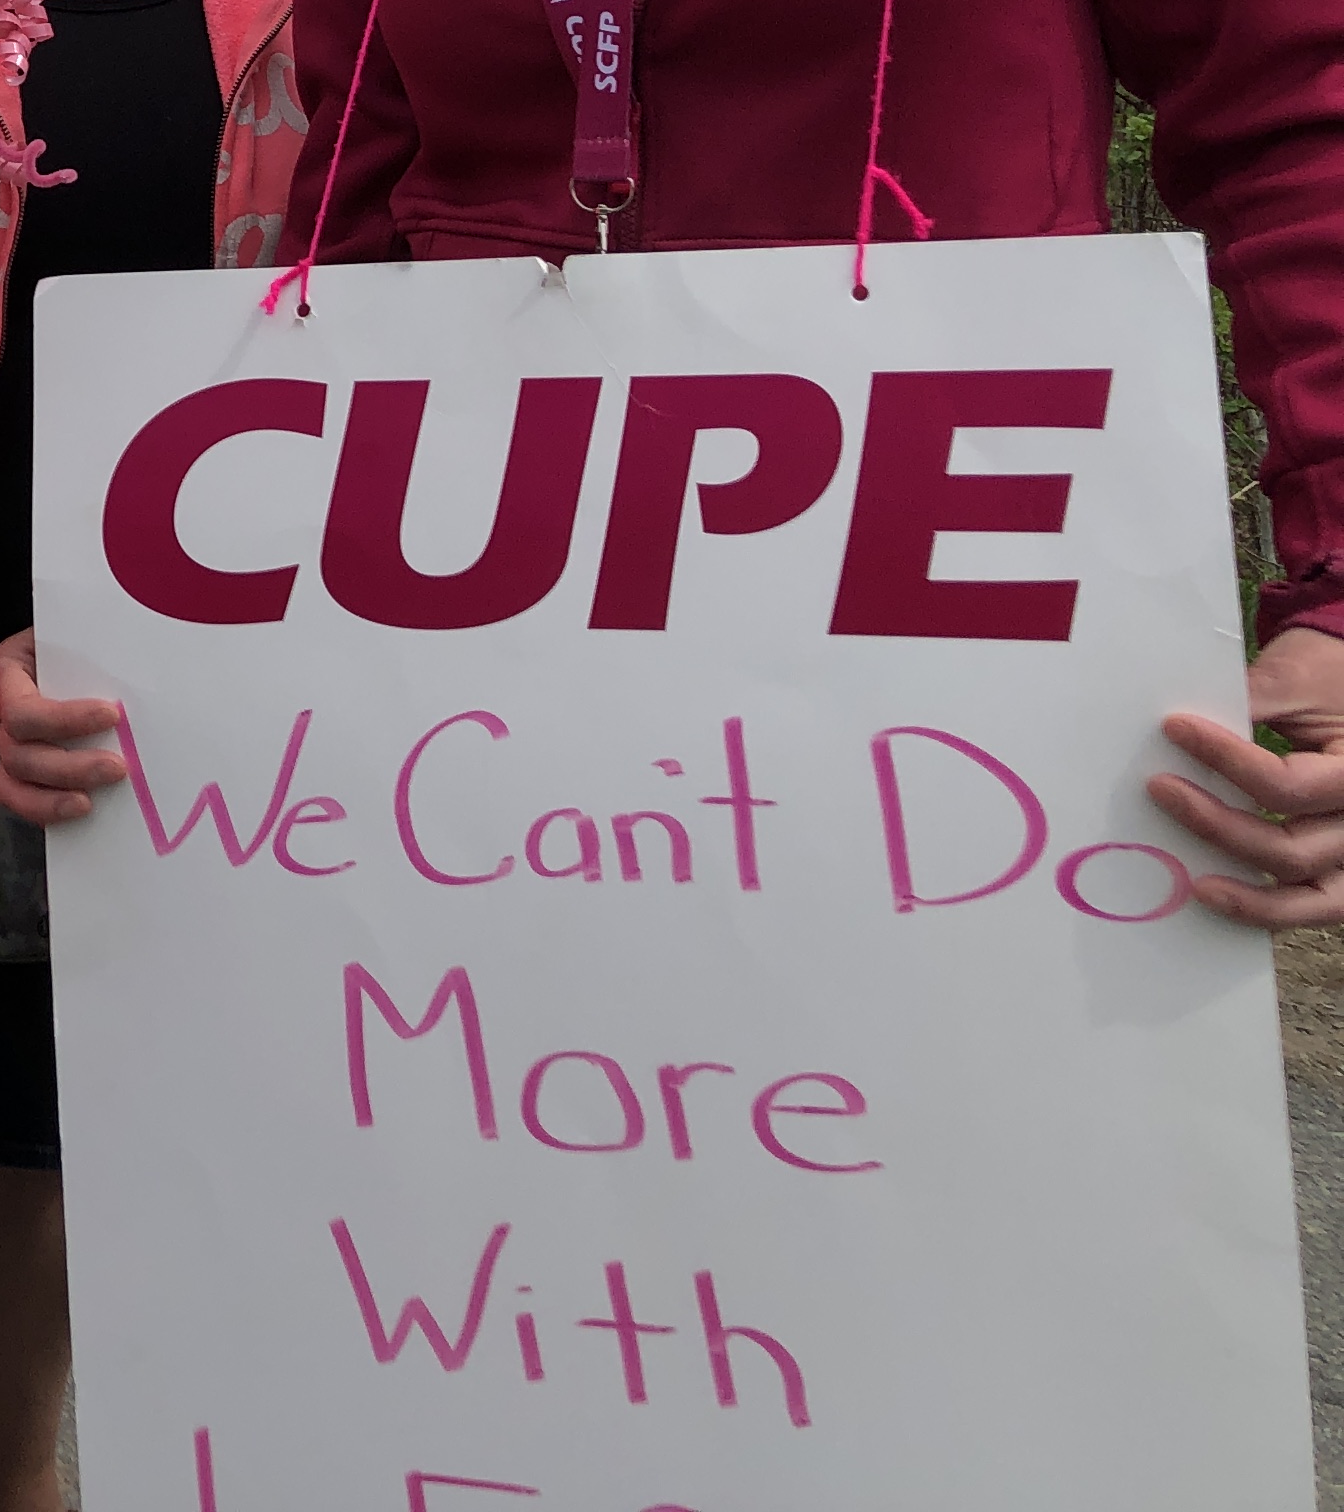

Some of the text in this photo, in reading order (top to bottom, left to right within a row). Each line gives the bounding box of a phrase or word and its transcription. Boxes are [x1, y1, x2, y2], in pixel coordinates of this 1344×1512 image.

[594, 11, 621, 93] SCFP
[102, 368, 1114, 643] CUPE
[115, 700, 1192, 924] We Can't Do
[342, 961, 884, 1175] More
[329, 1217, 812, 1429] With
